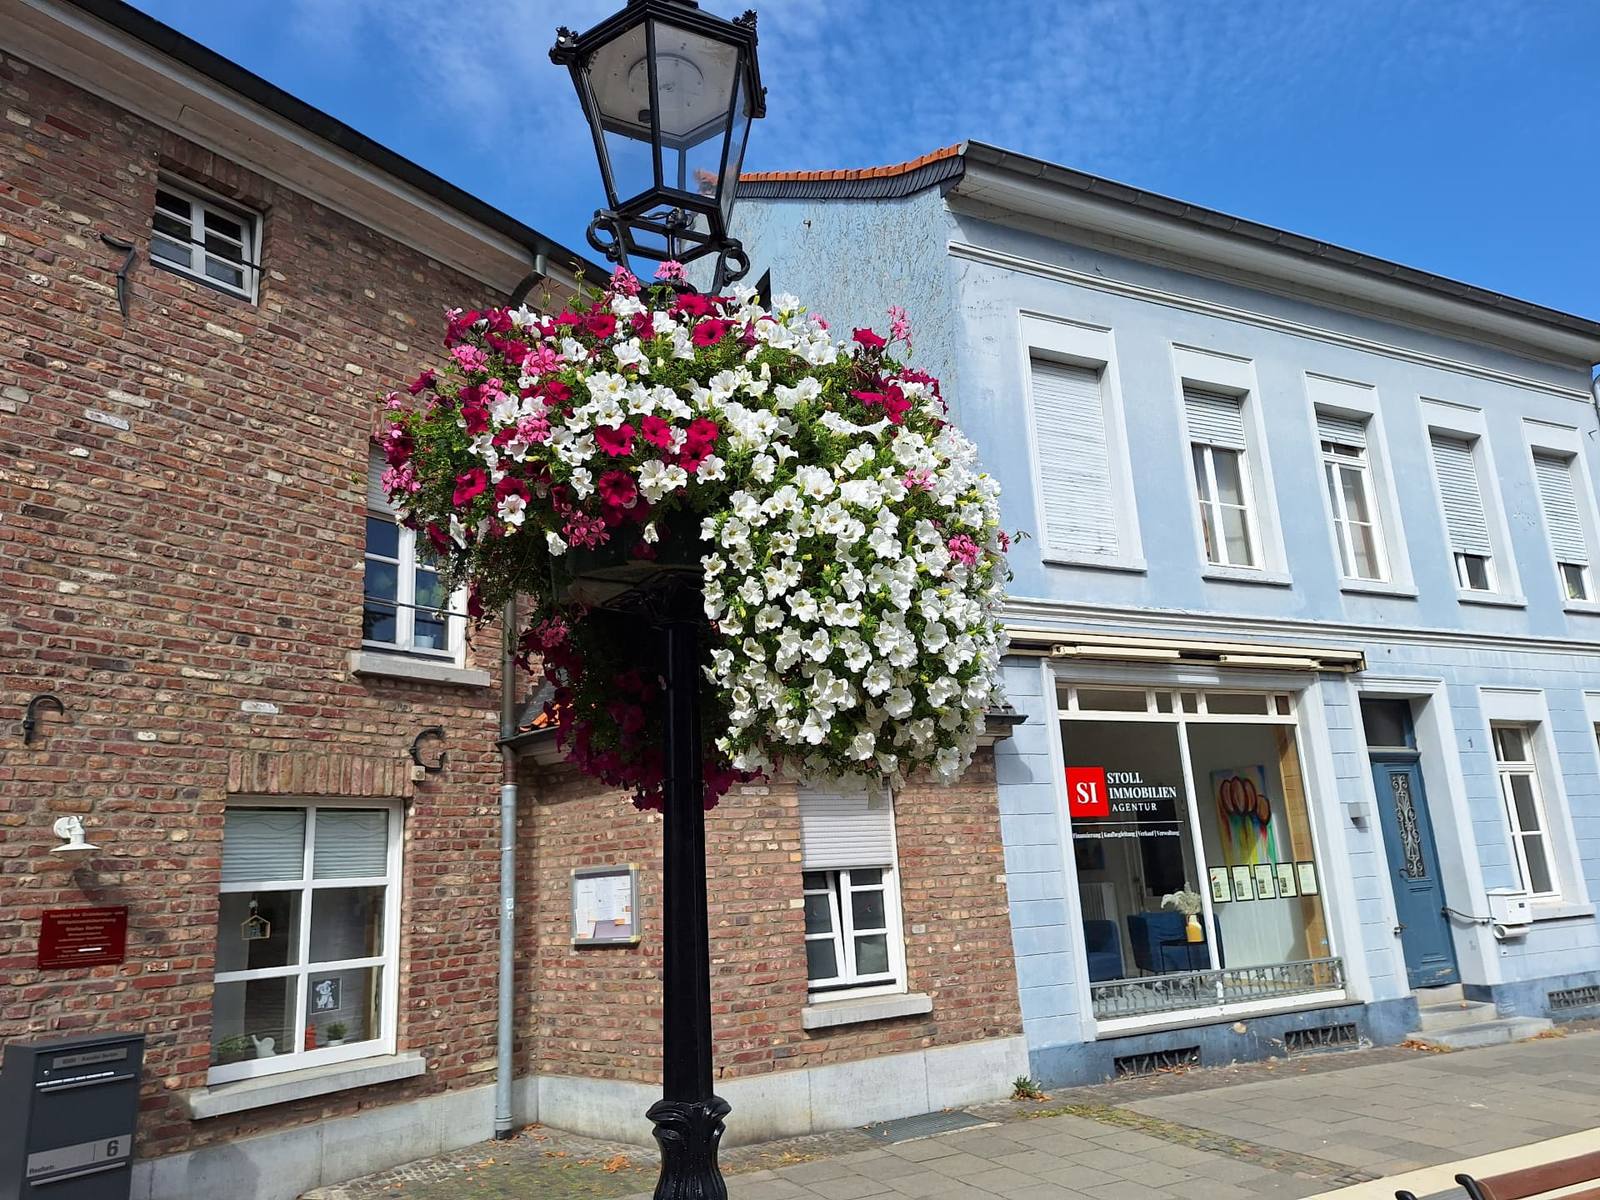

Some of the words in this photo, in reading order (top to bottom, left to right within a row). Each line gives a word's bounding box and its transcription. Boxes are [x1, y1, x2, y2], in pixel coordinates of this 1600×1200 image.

[1107, 772, 1143, 784] STOLL
[1076, 782, 1098, 804] SI
[1109, 786, 1177, 799] IMMOBILIEN
[1112, 802, 1157, 812] AGENTUR
[107, 1140, 119, 1157] 6
